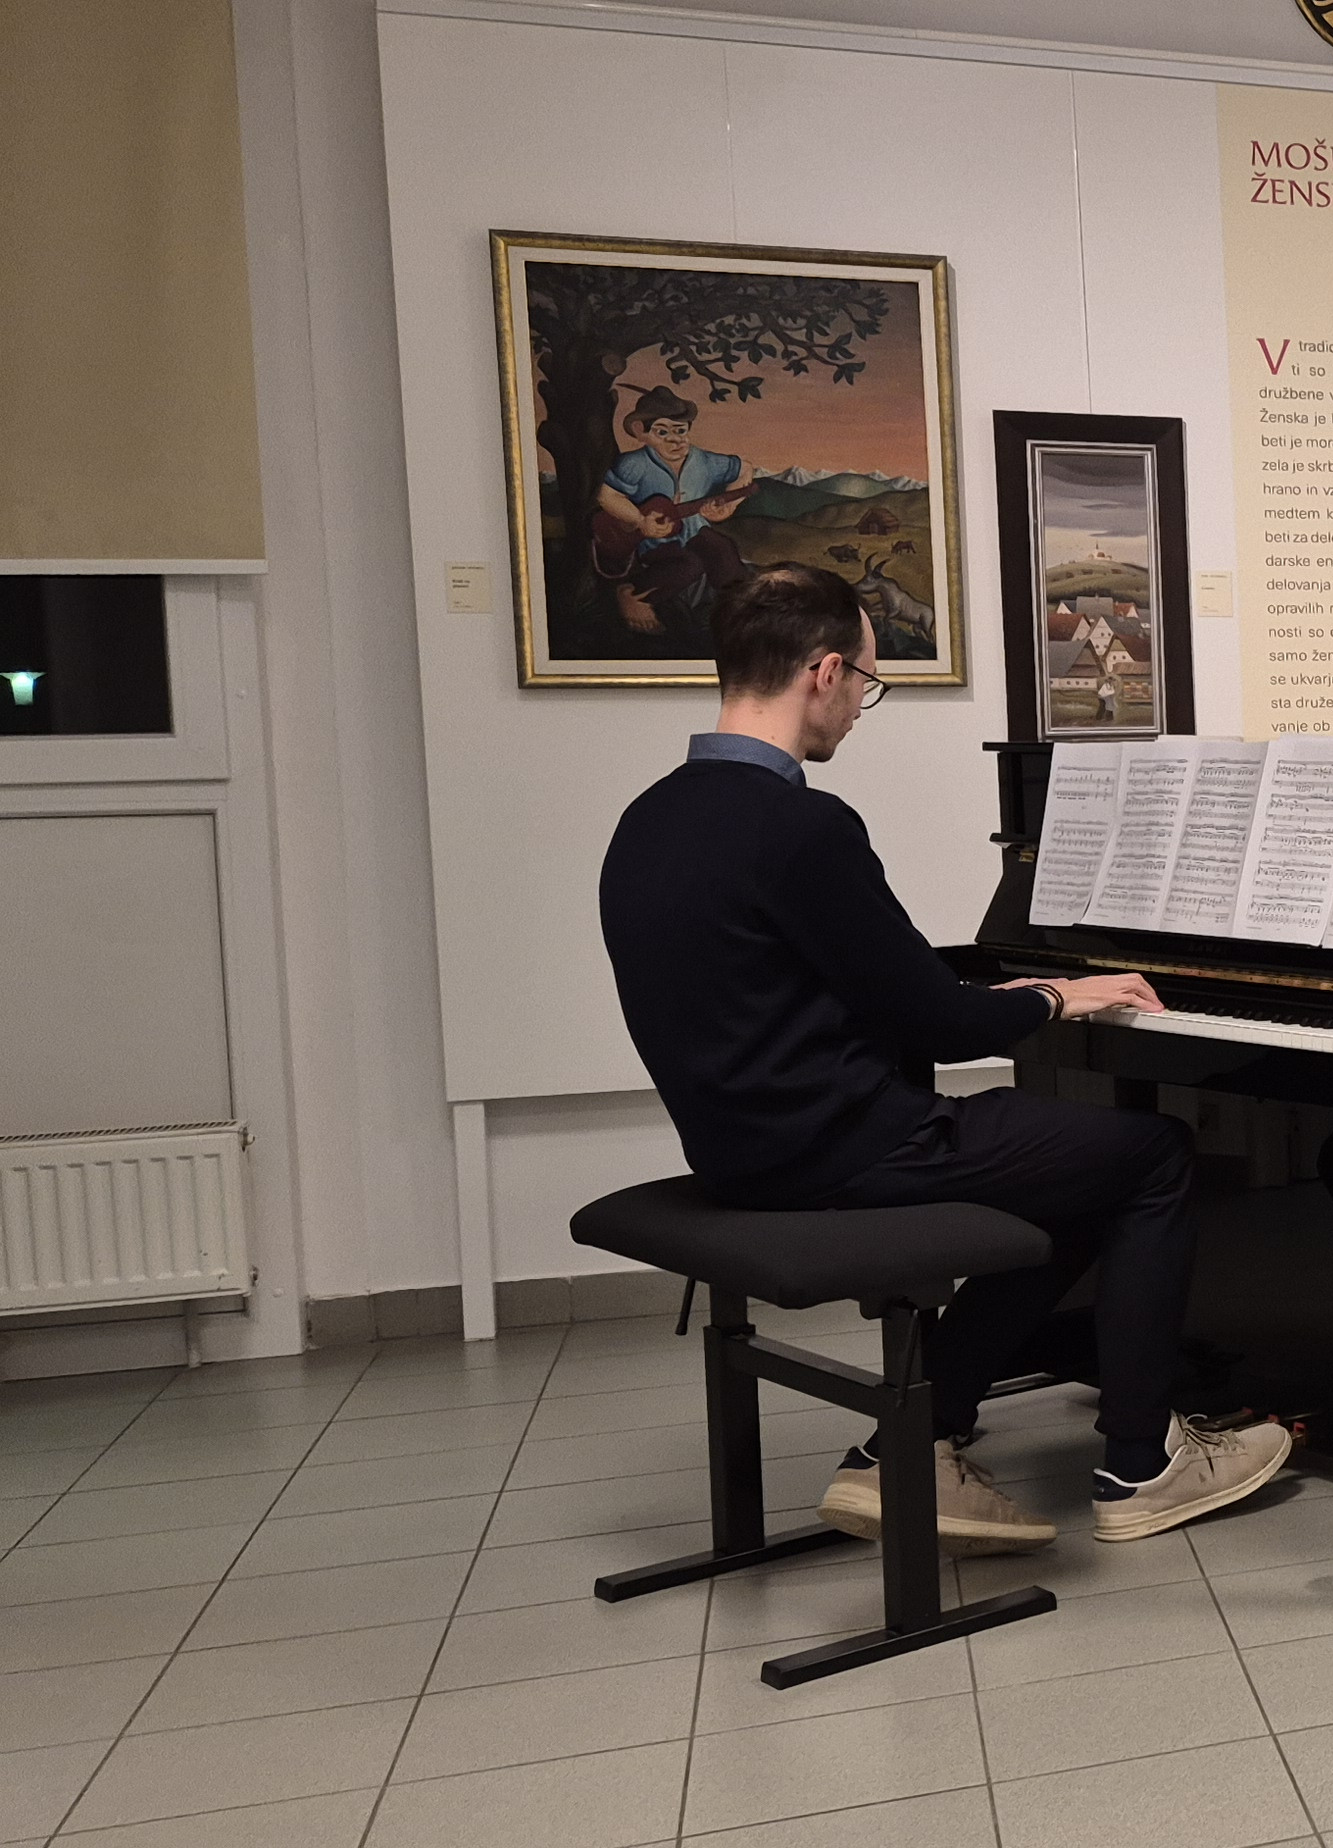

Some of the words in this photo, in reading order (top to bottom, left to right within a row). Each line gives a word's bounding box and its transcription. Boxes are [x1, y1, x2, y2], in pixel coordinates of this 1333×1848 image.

[1256, 338, 1290, 375] V
[1291, 363, 1300, 375] ti
[1310, 367, 1325, 377] so
[1259, 387, 1324, 400] družbene
[1260, 408, 1308, 424] Ženska
[1314, 412, 1326, 427] je
[1262, 435, 1286, 447] beti
[1290, 436, 1302, 450] je
[1262, 459, 1288, 471] zela
[1293, 460, 1304, 474] je
[1264, 483, 1301, 495] hrano
[1307, 484, 1318, 495] in
[1265, 507, 1320, 519] medtem
[1265, 531, 1289, 542] beti
[1293, 534, 1308, 543] za
[1266, 555, 1310, 566] darske
[1267, 579, 1330, 593] delovanja
[1268, 602, 1323, 616] opravilih
[1269, 626, 1301, 638] nosti
[1309, 629, 1324, 638] so
[1270, 652, 1307, 661] samo
[1270, 676, 1286, 685] se
[1271, 698, 1291, 708] sta
[1271, 721, 1308, 734] vanje
[1313, 720, 1330, 732] ob
